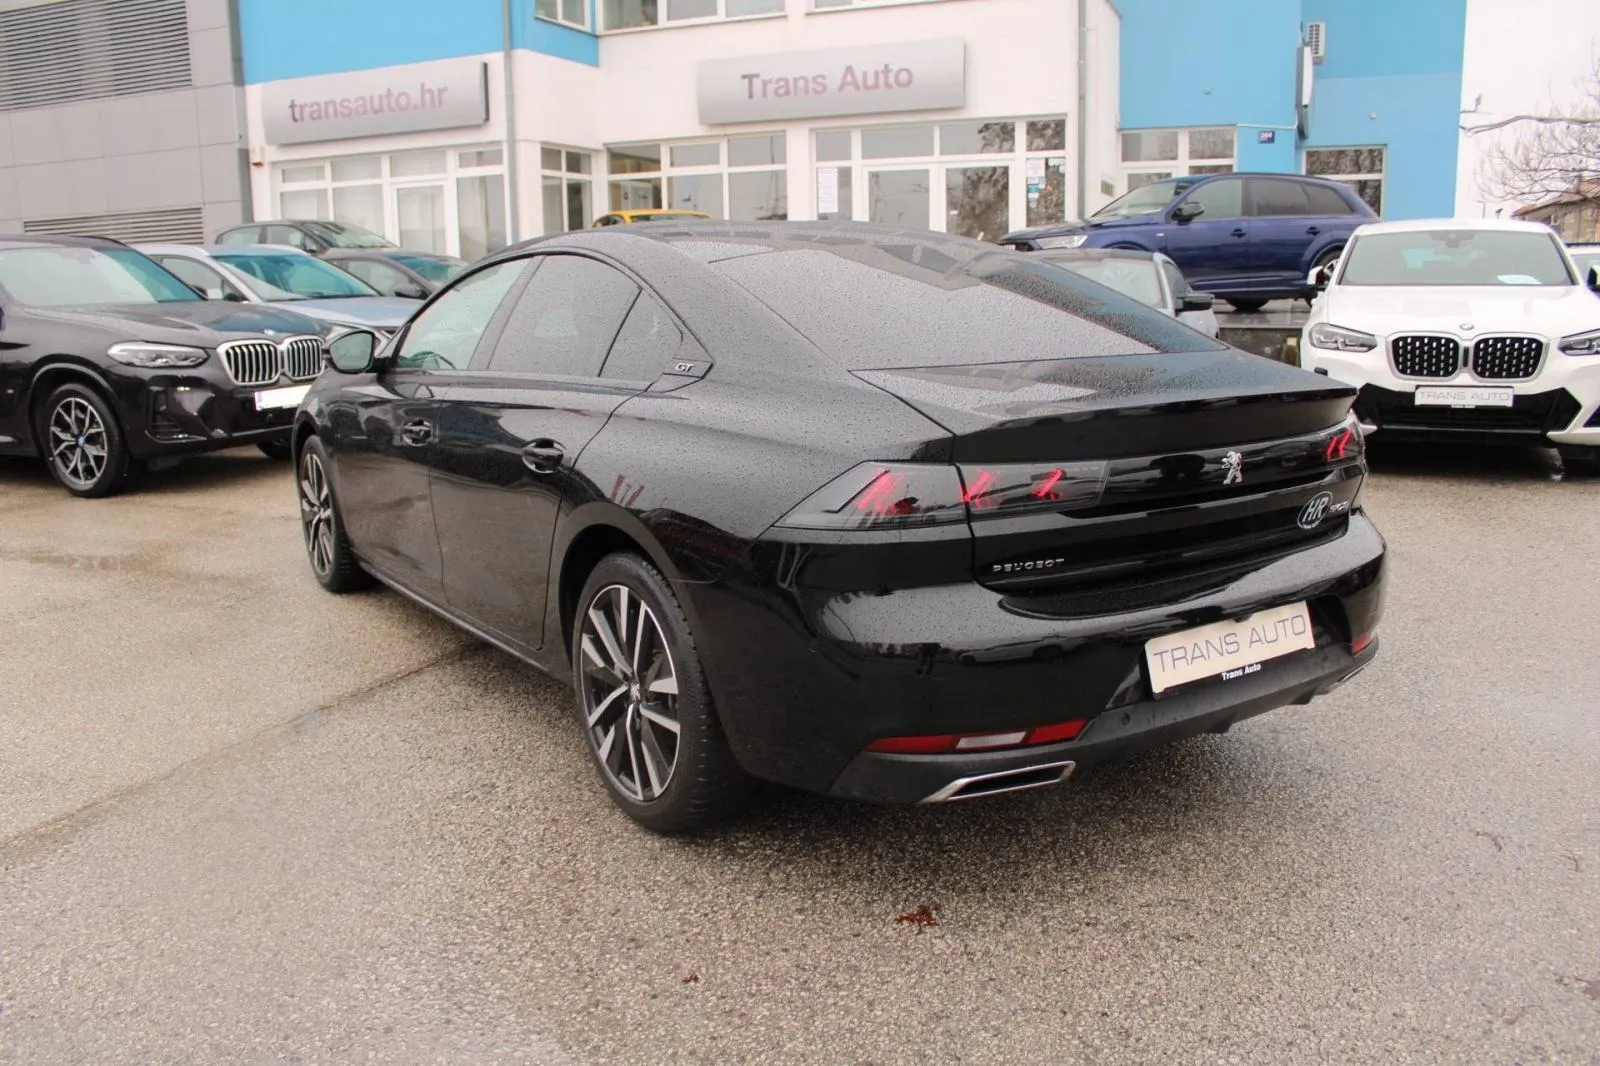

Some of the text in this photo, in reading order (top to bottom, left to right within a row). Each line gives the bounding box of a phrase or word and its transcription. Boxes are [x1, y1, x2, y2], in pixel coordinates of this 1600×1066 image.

[741, 64, 914, 99] Trans Auto
[288, 82, 448, 123] transauto.hr
[675, 362, 695, 372] GT
[1420, 391, 1510, 401] TRANS AUTO
[1302, 497, 1329, 522] HR
[992, 558, 1065, 573] PEUGEOT
[1153, 615, 1306, 673] TRANS AUTO
[1221, 664, 1262, 681] Trans Auto
